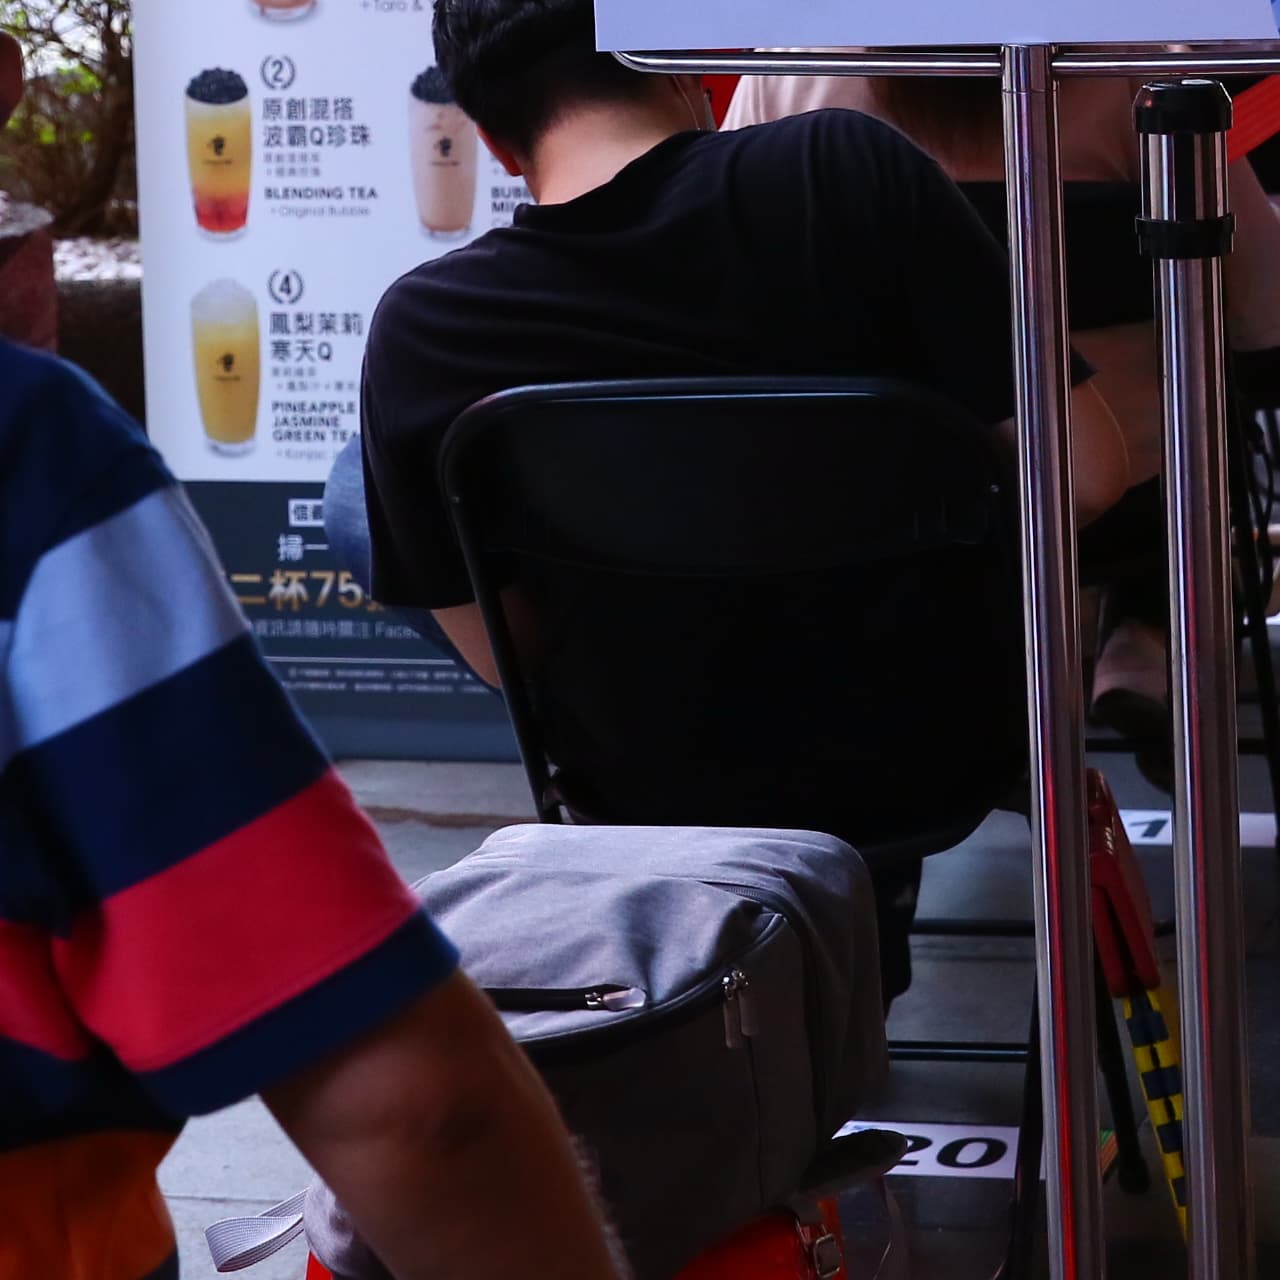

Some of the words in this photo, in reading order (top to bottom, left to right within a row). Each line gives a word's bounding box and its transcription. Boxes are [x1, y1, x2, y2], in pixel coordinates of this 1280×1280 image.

[271, 59, 284, 83] 2
[264, 186, 343, 200] BLENDING
[348, 186, 378, 200] TEA
[278, 274, 292, 296] 4
[271, 338, 333, 363] 寒天Q
[272, 400, 356, 414] PINEAPPLE
[272, 414, 341, 428] JASMINE
[272, 429, 326, 443] GREEN
